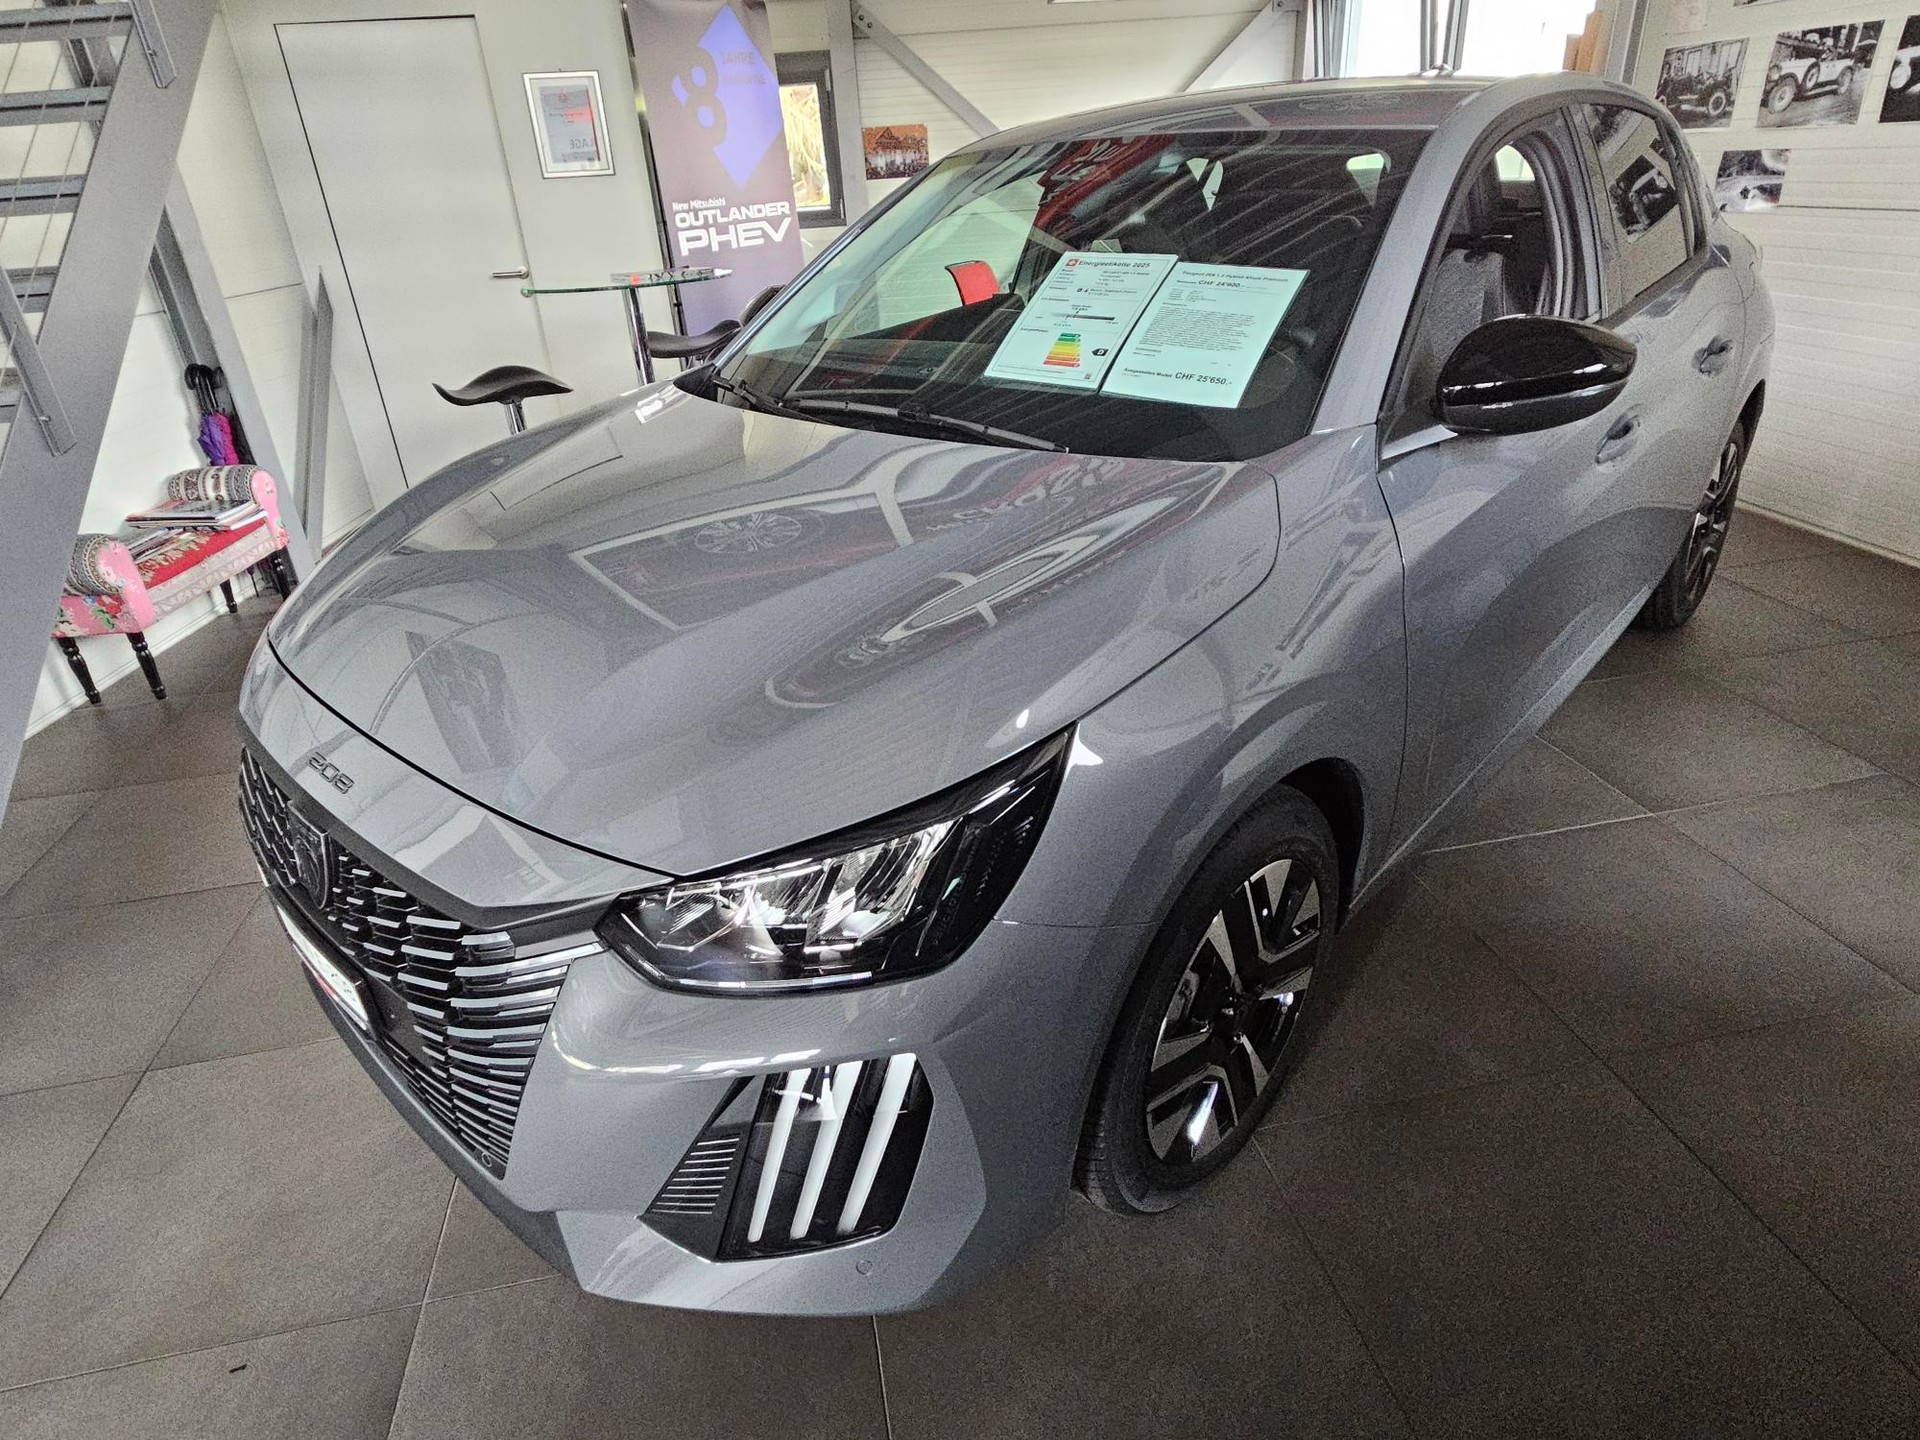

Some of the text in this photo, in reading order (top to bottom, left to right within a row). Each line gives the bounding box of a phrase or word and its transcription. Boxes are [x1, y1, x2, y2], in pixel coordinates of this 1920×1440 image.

[672, 197, 726, 211] New Mitsubishi
[675, 201, 791, 228] OUTLANDER
[678, 217, 792, 256] PHEV
[1175, 371, 1196, 381] CHF
[306, 751, 355, 794] 208
